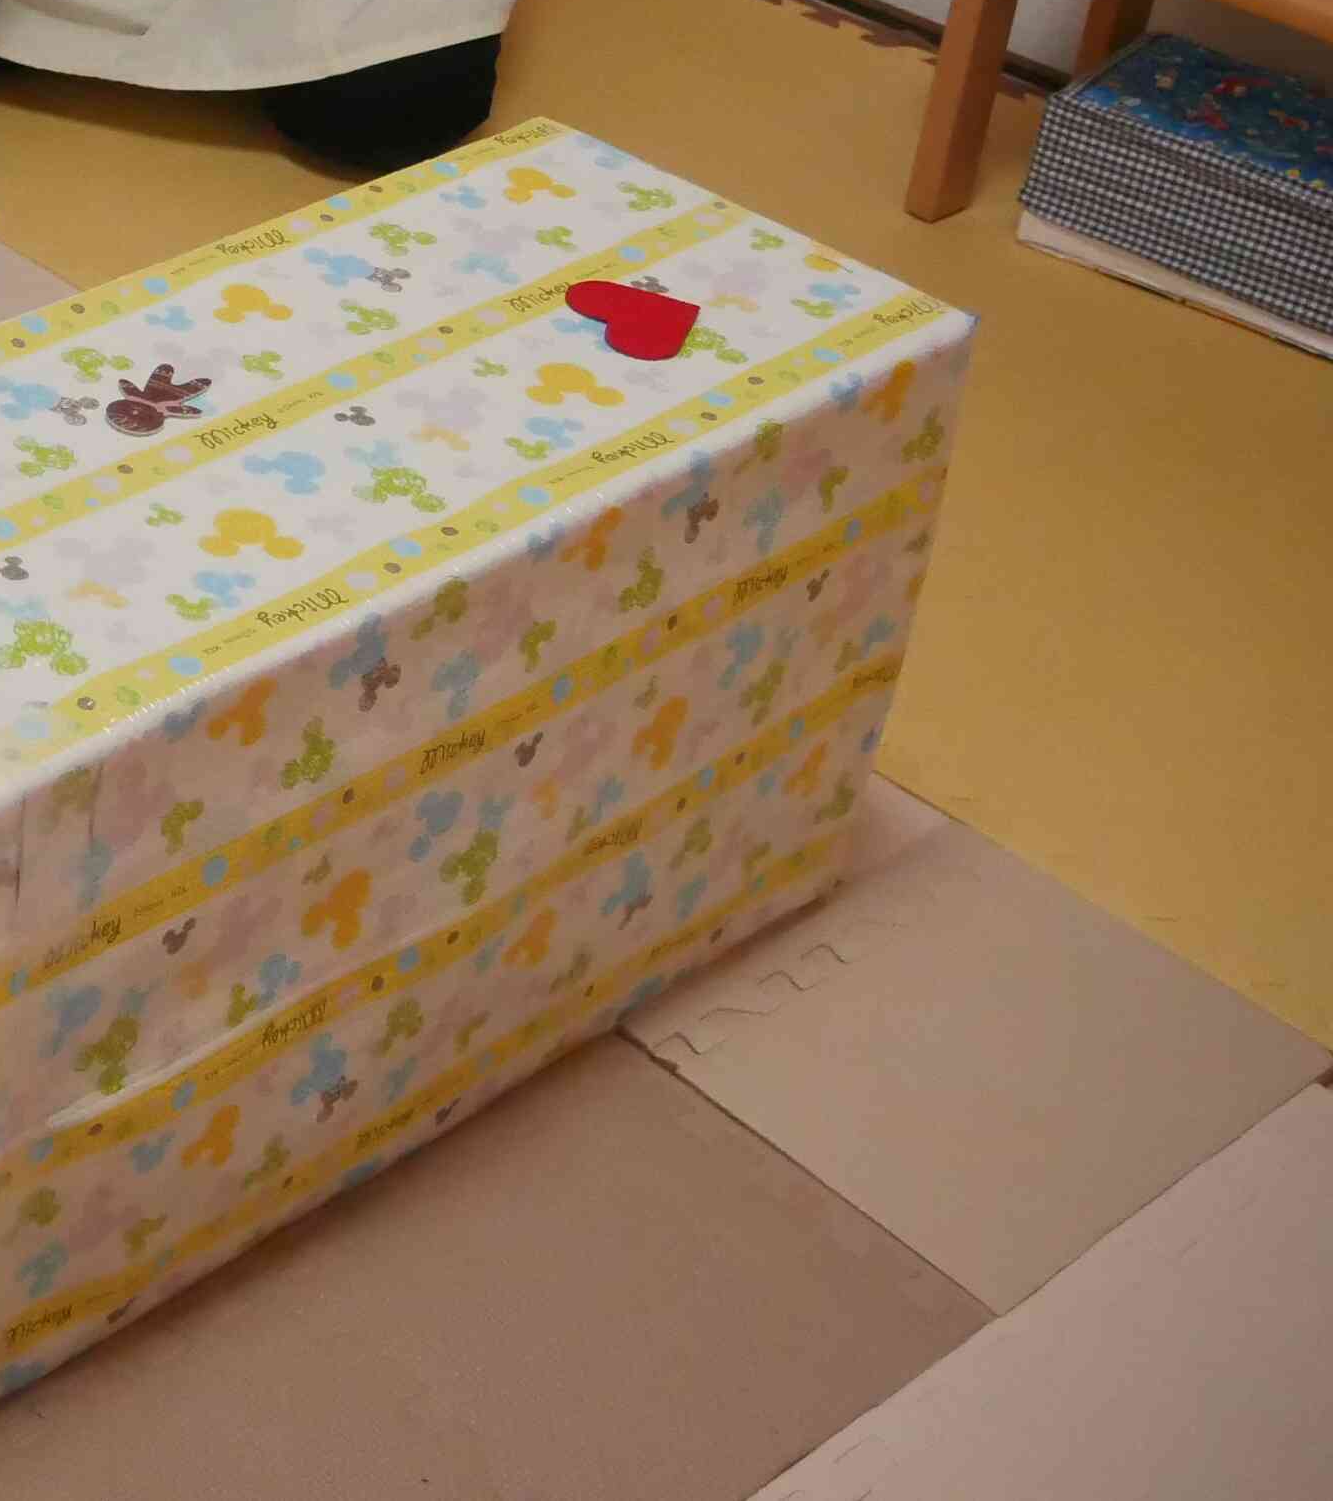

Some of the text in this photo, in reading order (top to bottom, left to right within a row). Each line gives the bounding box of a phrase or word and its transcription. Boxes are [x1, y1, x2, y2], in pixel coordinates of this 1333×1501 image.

[191, 412, 279, 449] Mickey
[591, 431, 675, 464] Mickey
[254, 587, 350, 629] Mickey
